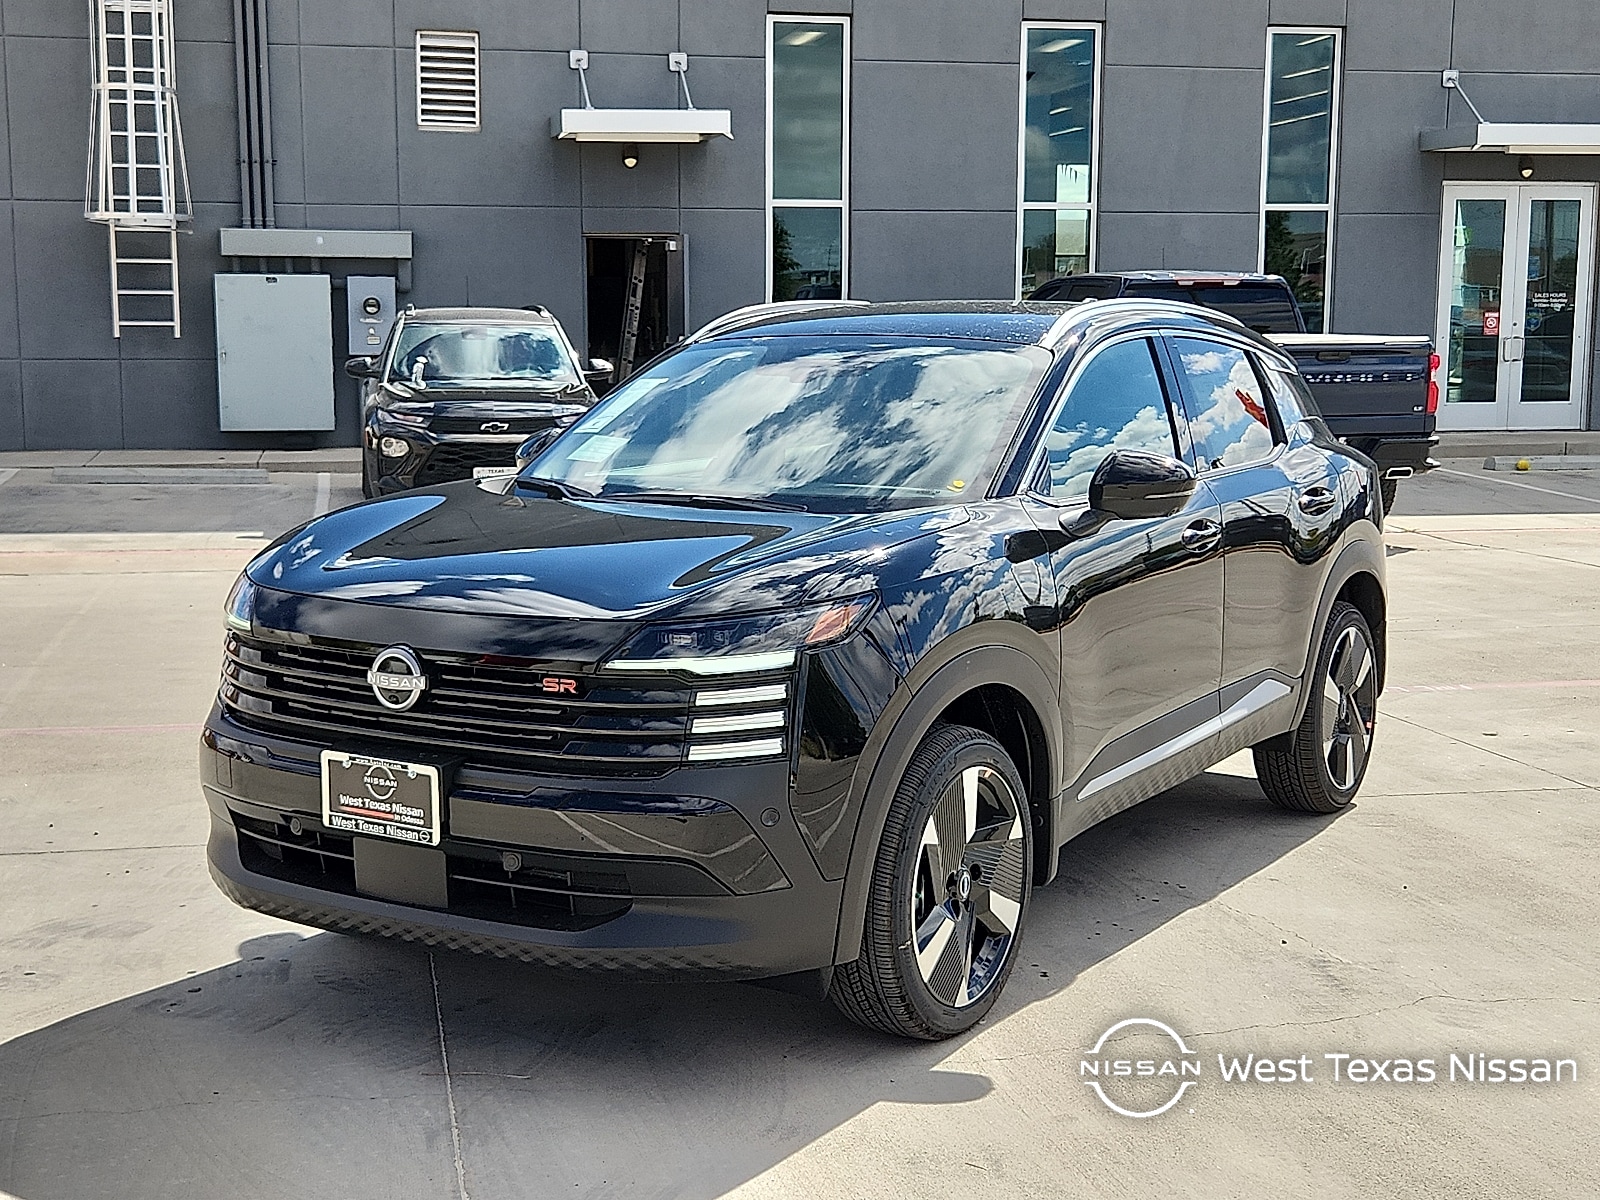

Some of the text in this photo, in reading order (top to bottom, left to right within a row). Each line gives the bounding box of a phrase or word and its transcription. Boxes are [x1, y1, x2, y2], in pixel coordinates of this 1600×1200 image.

[368, 673, 426, 689] NISSAN
[542, 677, 578, 694] SR
[363, 776, 397, 788] NISSAN
[339, 794, 424, 818] West Texas Nissan
[331, 815, 419, 840] West Texas Nissan
